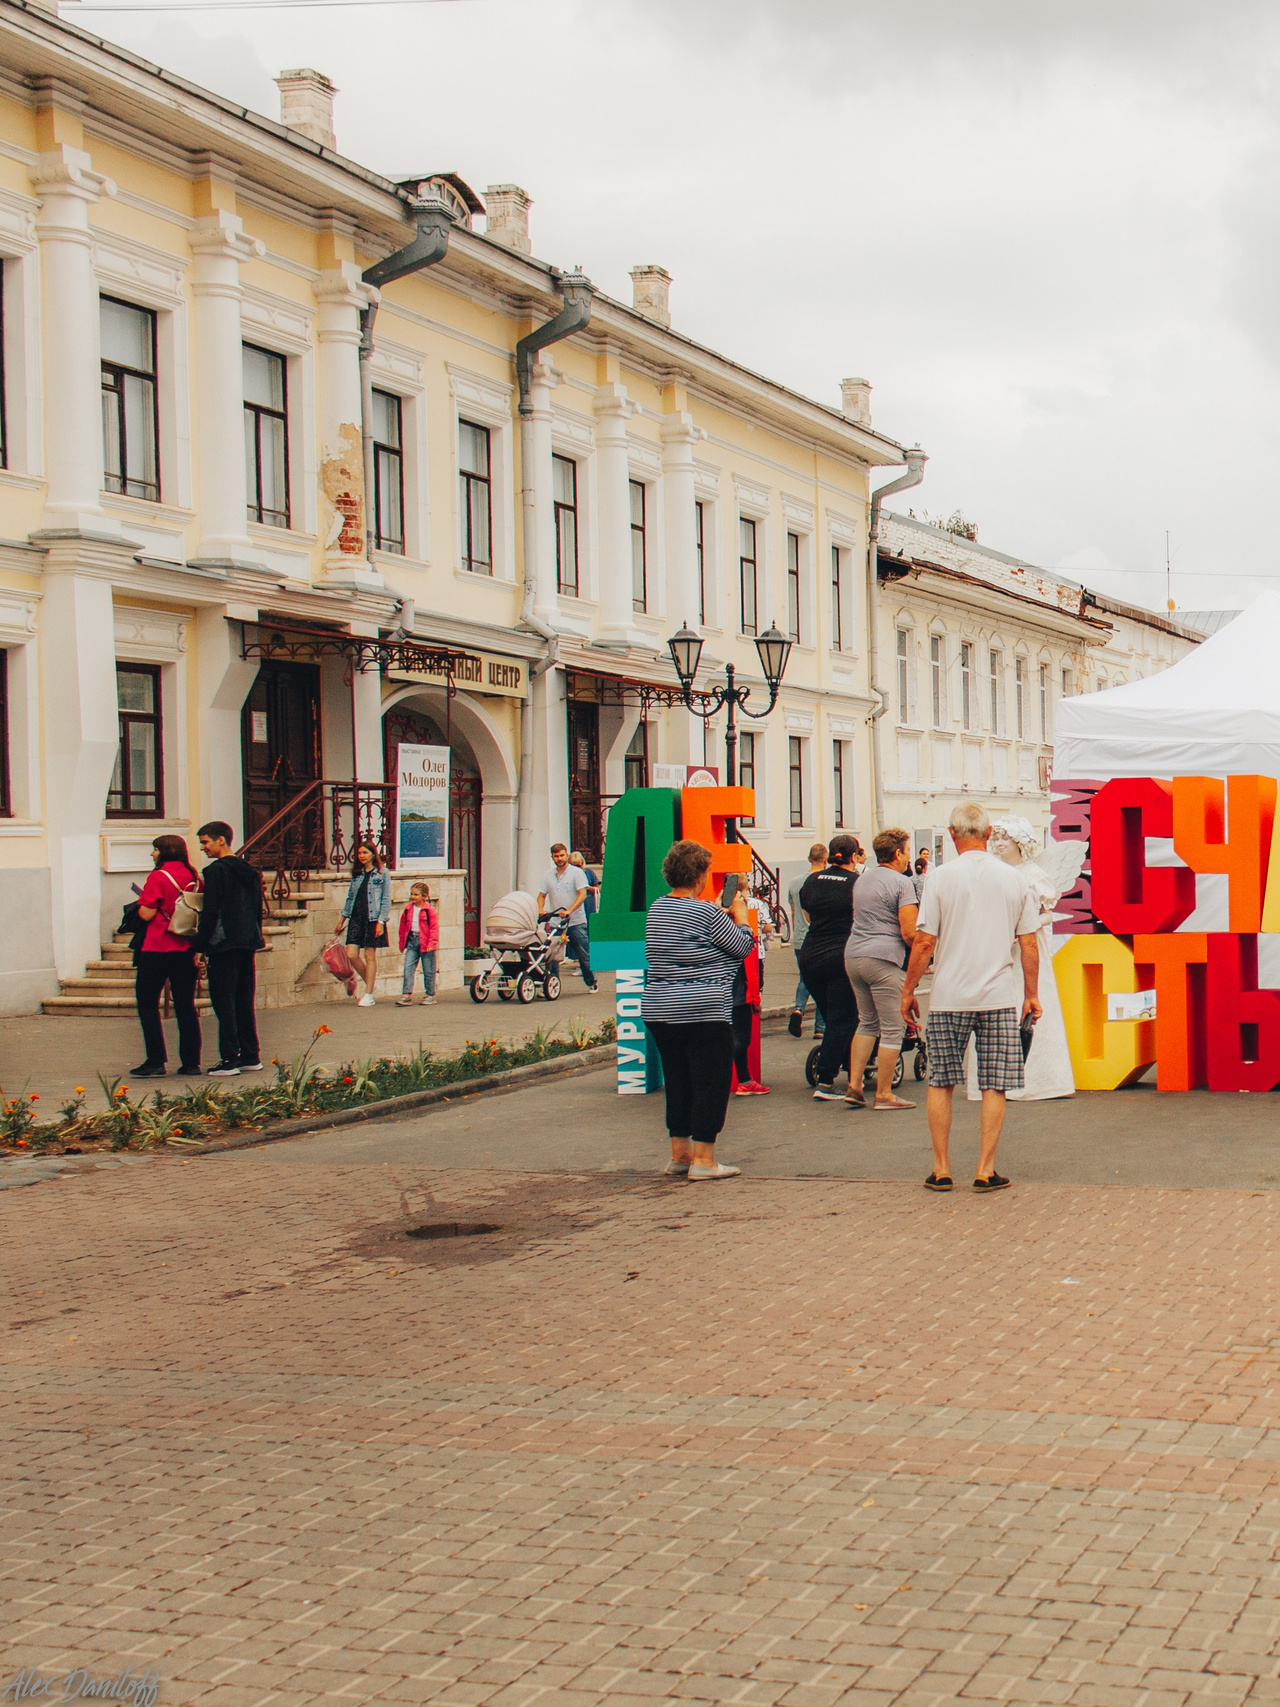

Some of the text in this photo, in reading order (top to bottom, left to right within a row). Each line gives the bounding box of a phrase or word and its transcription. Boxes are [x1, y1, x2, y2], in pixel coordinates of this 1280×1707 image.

[488, 662, 521, 688] ЦЕНТР
[422, 758, 447, 773] Олег
[402, 772, 447, 791] Модоров
[615, 969, 646, 1095] МУРОМ
